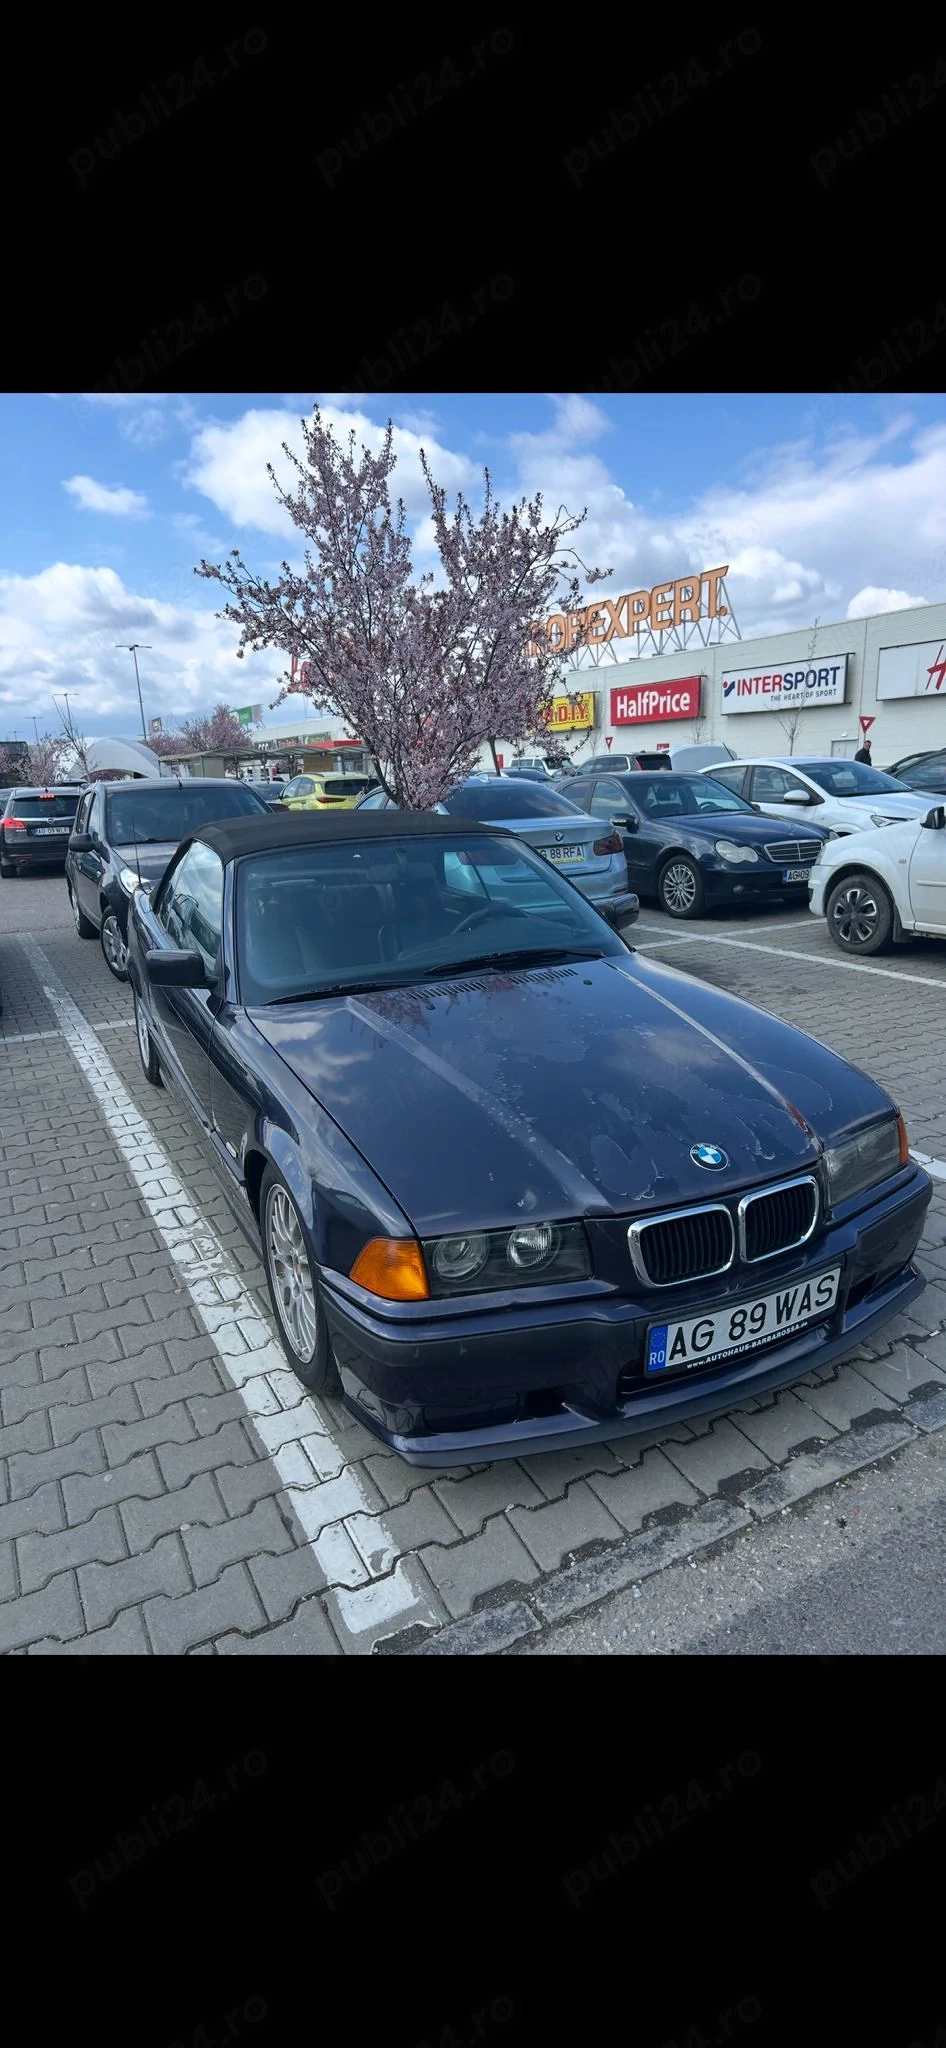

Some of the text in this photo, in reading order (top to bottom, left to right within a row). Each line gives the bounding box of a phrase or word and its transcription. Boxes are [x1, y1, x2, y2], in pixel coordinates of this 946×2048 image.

[737, 666, 840, 696] INTERSPORT
[616, 690, 691, 719] HalfPrice
[770, 688, 837, 703] THE HEART OF SPORT
[549, 848, 562, 859] 88
[563, 847, 582, 859] RFA
[787, 870, 798, 881] AG
[668, 1274, 835, 1361] AG 89 WAS
[686, 1321, 808, 1369] www.AUTOHAUS-BARBAROSSA.de
[650, 1350, 665, 1366] RO
